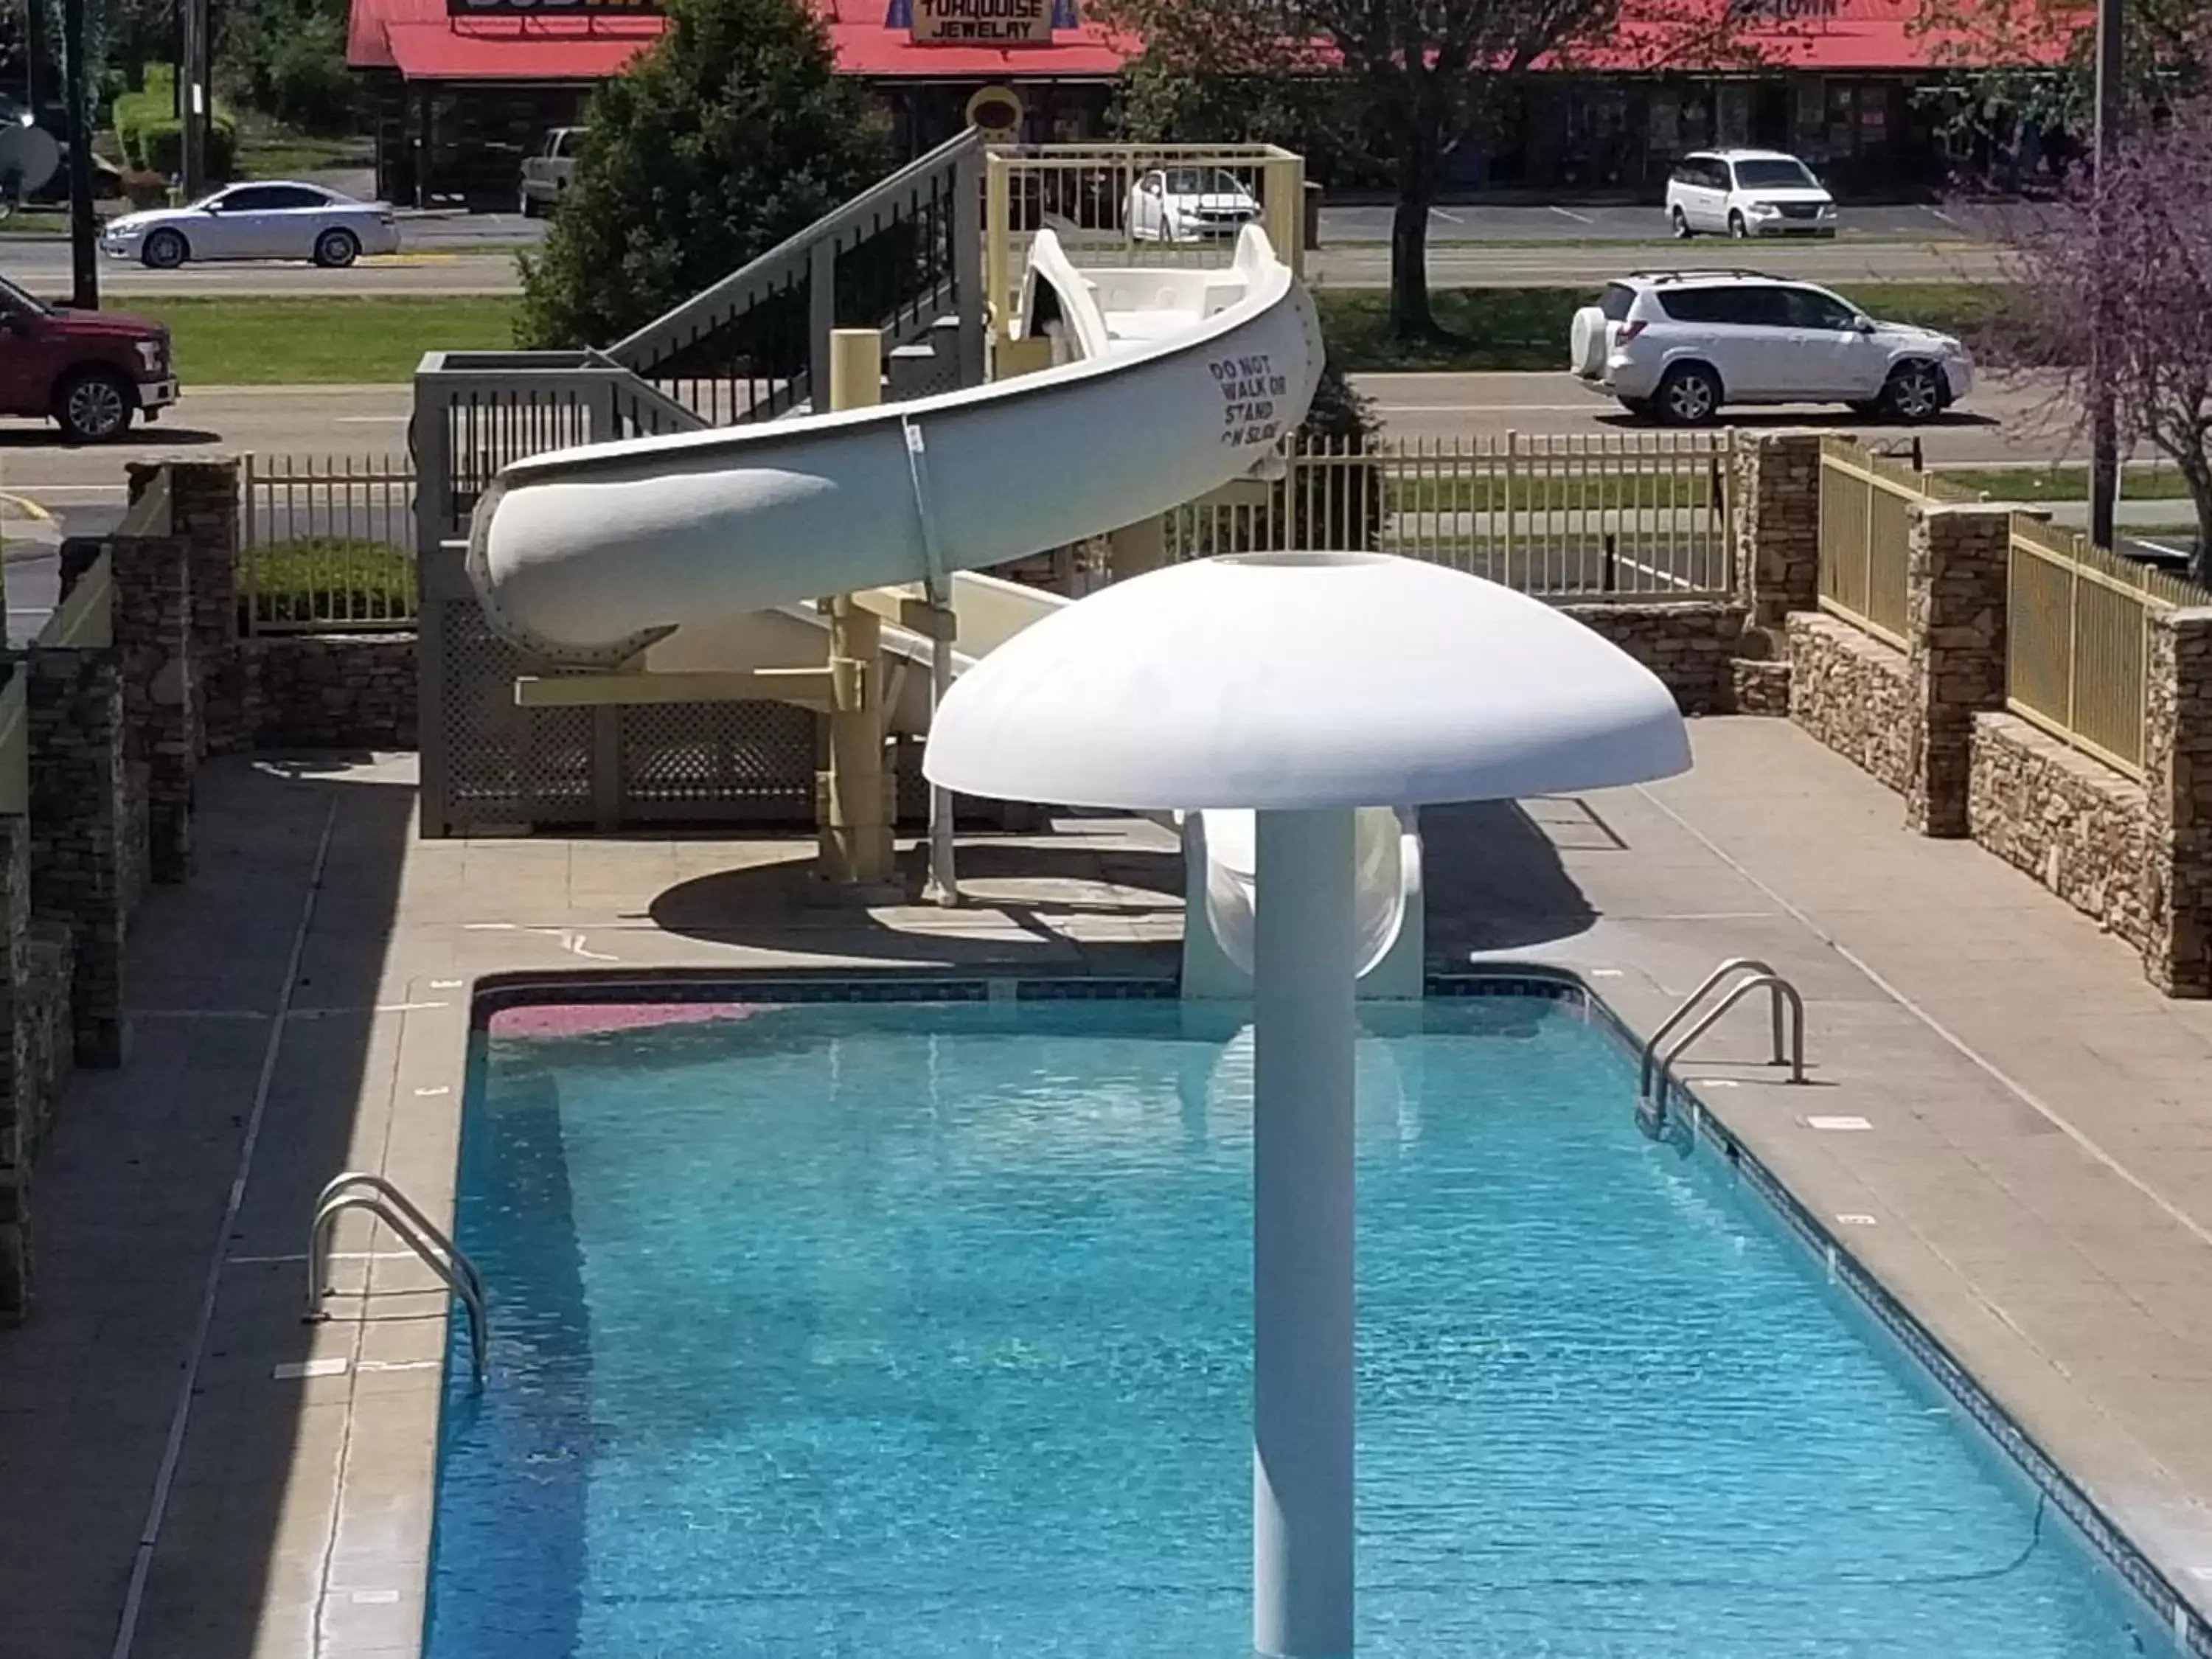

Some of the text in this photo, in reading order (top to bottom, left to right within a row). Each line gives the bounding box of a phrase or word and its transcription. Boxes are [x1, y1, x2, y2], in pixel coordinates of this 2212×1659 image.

[922, 0, 1042, 20] TURQUOISE
[932, 21, 1031, 38] JEWELRY
[1209, 355, 1270, 380] DO NOT
[1221, 376, 1286, 400] WALK OR
[1225, 401, 1273, 425] STAND
